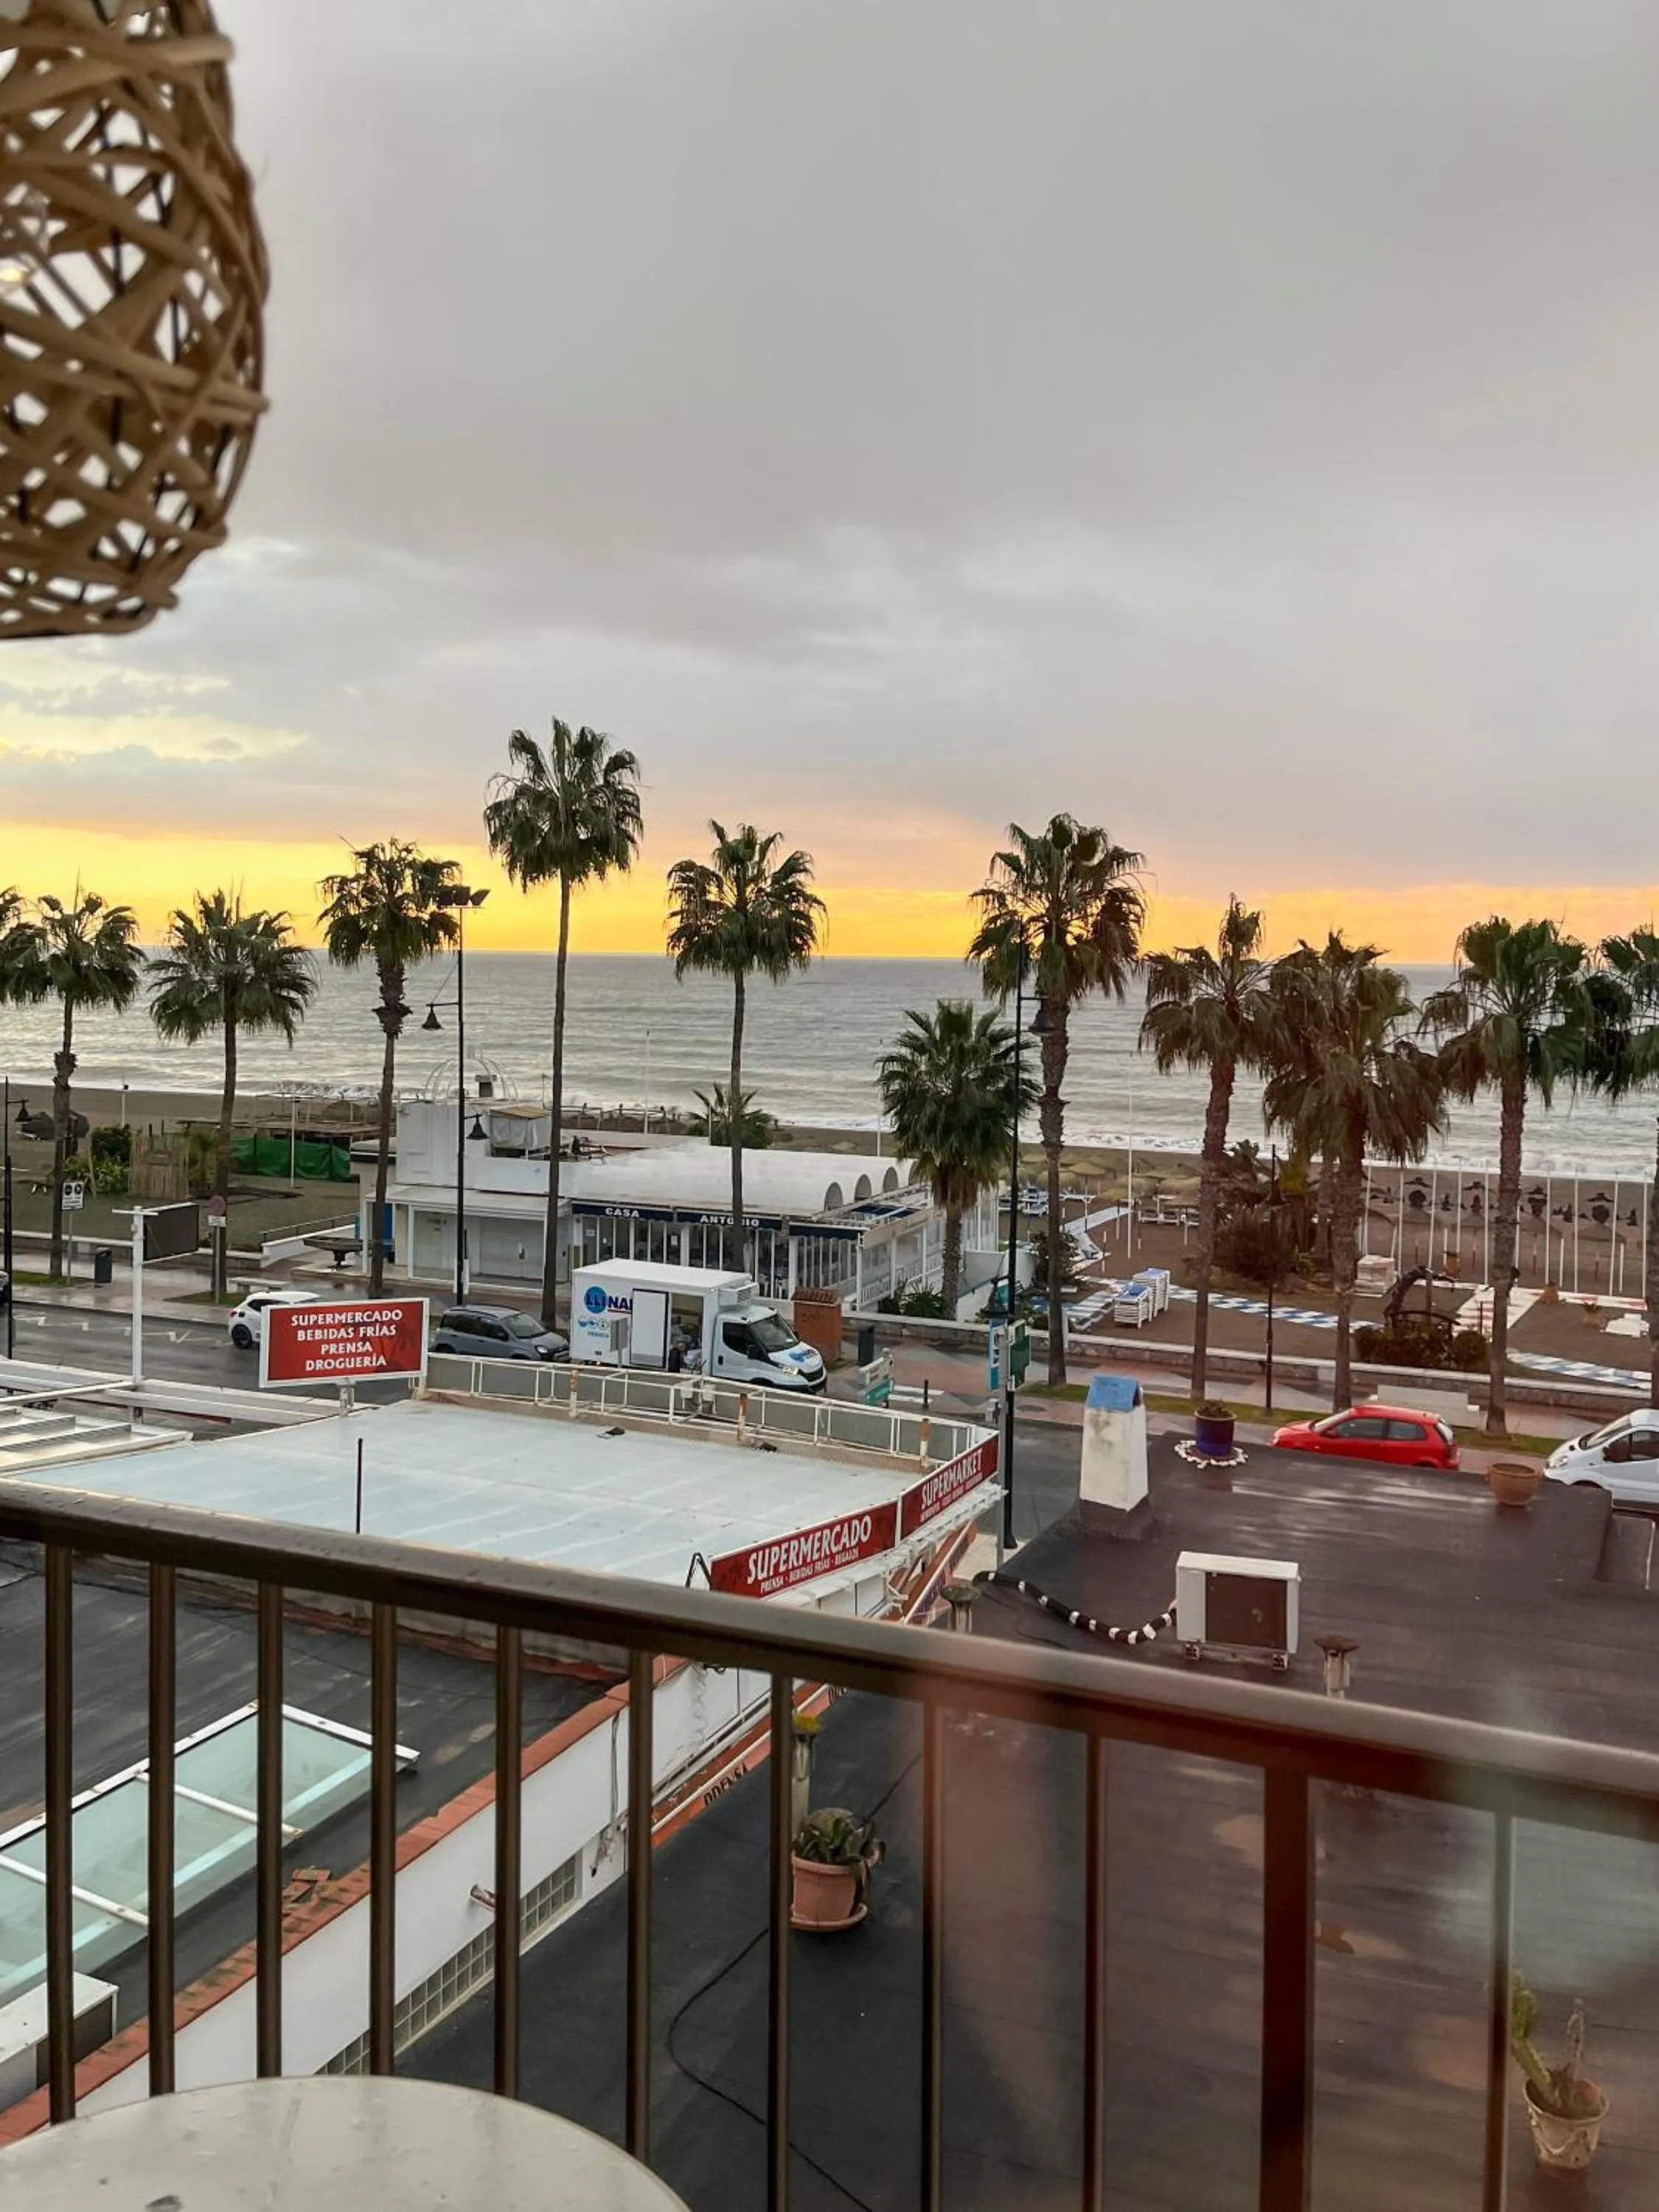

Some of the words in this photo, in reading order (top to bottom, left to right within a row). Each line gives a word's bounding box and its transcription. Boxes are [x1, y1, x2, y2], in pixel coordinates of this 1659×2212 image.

[605, 1207, 640, 1217] CASA
[291, 1310, 403, 1326] SUPERMERCADO
[297, 1327, 354, 1341] BEBIDAS
[359, 1323, 397, 1338] FRÍAS
[321, 1341, 372, 1354] PRENSA
[306, 1353, 387, 1371] DROGUERÍA
[921, 1447, 983, 1511] SUPERMARKET
[747, 1514, 872, 1585] SUPERMERCADO
[760, 1575, 784, 1593] PRENSA
